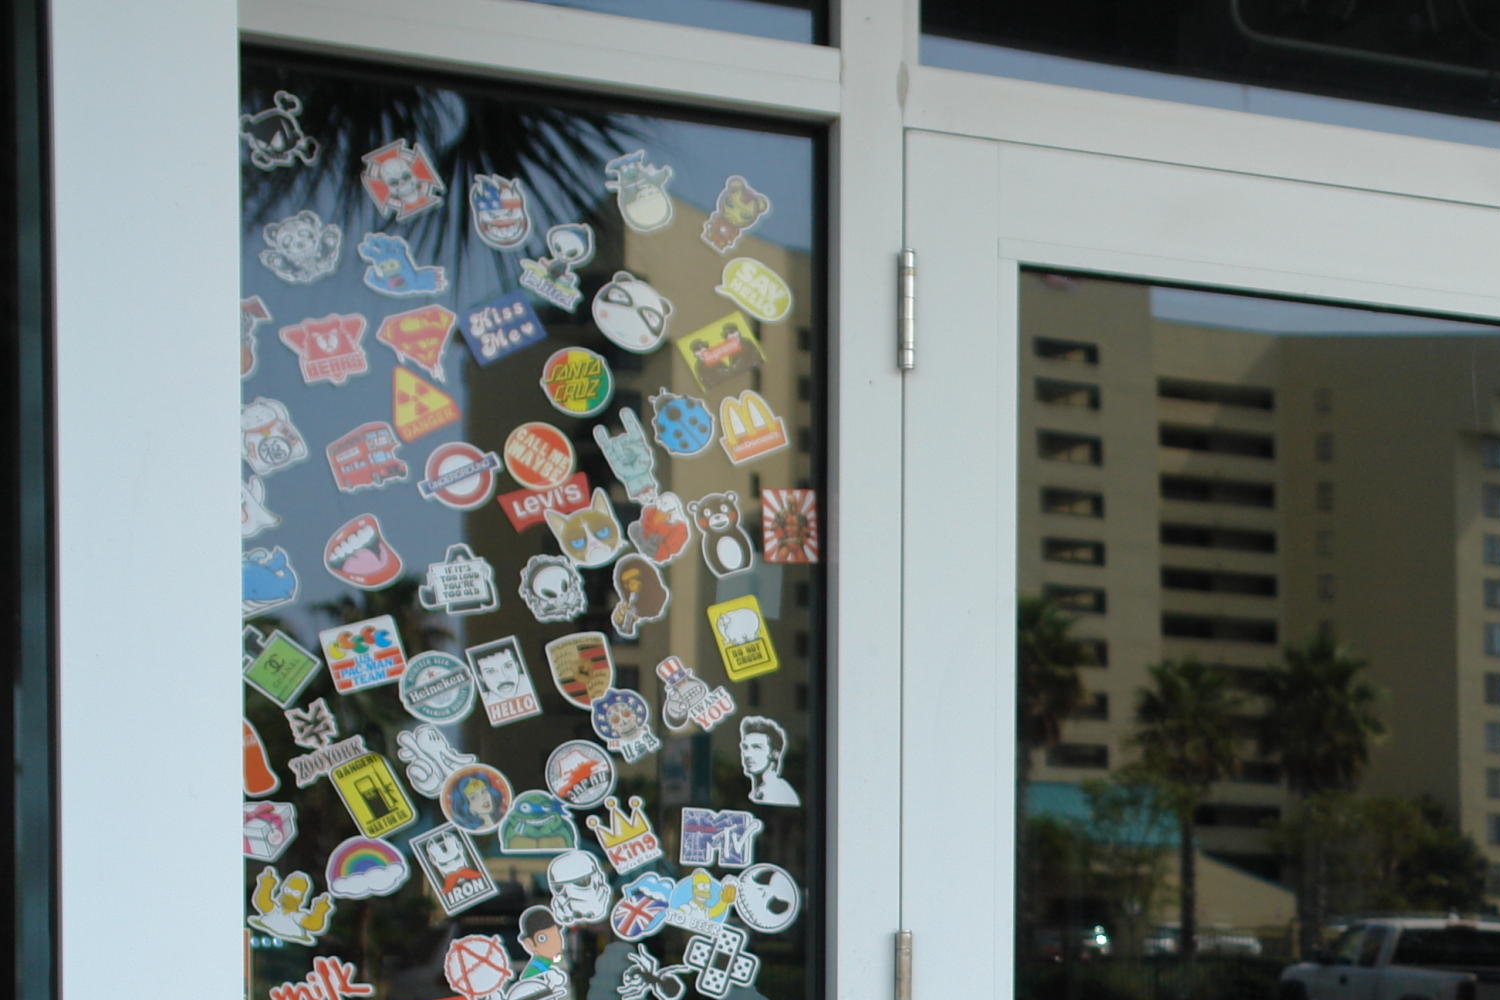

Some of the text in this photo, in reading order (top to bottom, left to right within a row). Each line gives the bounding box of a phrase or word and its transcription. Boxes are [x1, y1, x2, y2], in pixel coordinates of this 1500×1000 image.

[737, 261, 785, 300] SAY
[731, 276, 777, 318] HELLO
[469, 302, 525, 338] Kiss
[480, 328, 522, 358] Me
[545, 362, 602, 385] SANTA
[553, 379, 600, 403] CRUZ
[404, 408, 457, 439] DANGER
[507, 439, 565, 486] MAYBE
[516, 427, 571, 471] CALL ME
[428, 458, 491, 491] UNDERGROUND
[512, 483, 583, 518] Levi's
[442, 580, 475, 590] YOU'RE
[458, 573, 480, 582] LOUD
[340, 658, 394, 679] PAC-MAN
[352, 671, 387, 685] TEAM
[408, 671, 467, 703] Heineken
[490, 694, 535, 722] HELLO
[696, 696, 735, 730] YOU
[295, 741, 360, 780] ZOO YORK
[567, 770, 608, 801] JAPAN
[607, 834, 658, 867] king
[448, 878, 485, 905] IRON
